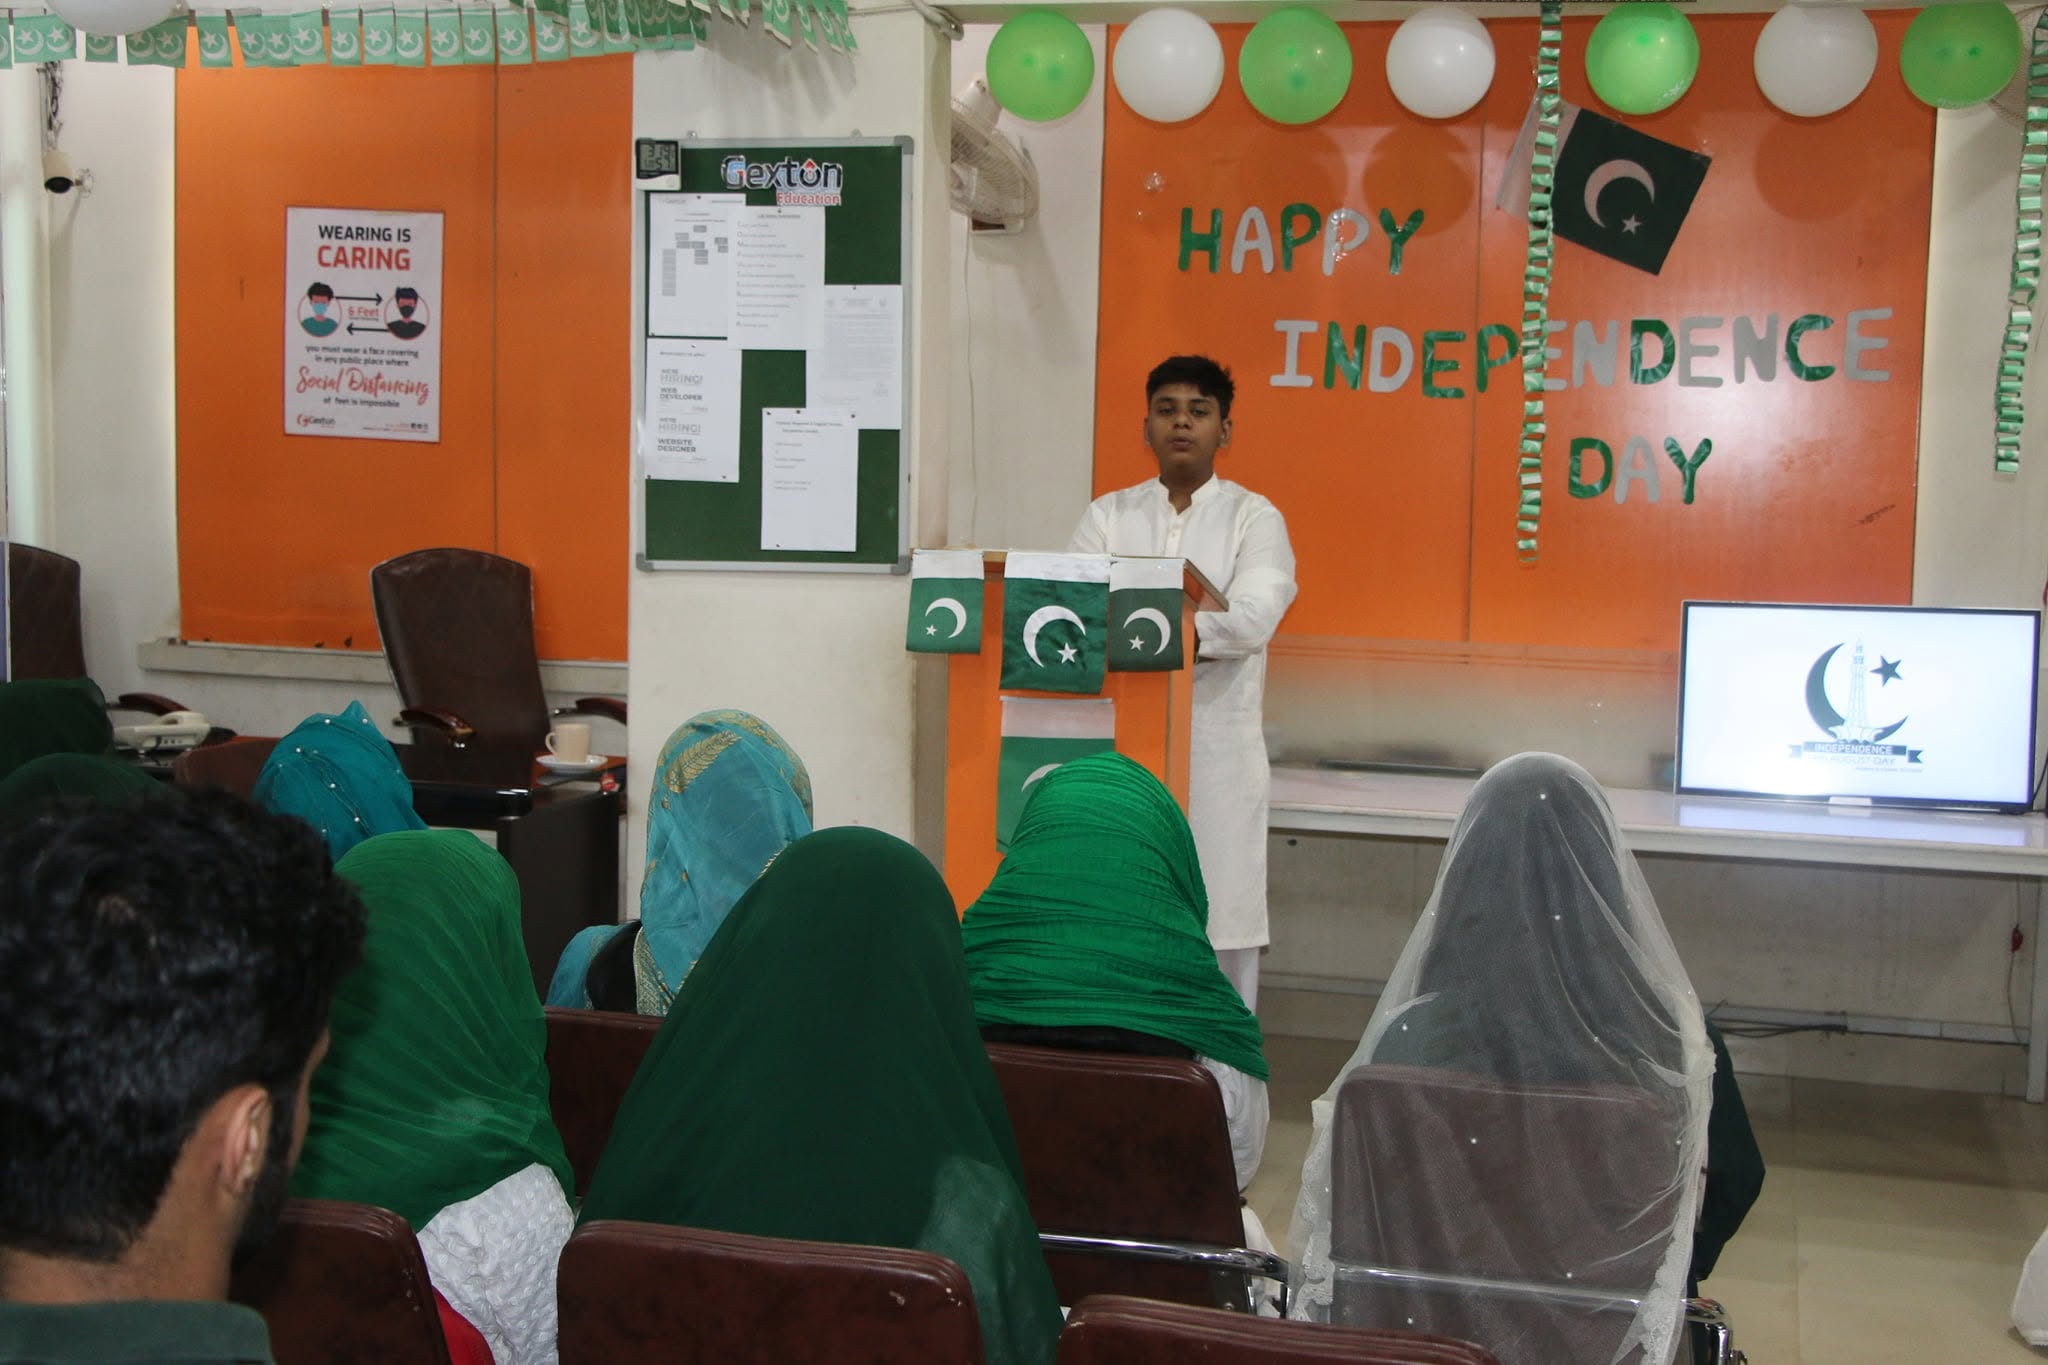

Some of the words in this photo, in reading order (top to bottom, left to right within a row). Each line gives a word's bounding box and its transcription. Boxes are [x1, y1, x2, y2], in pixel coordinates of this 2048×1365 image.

[721, 154, 842, 189] Gexton
[776, 191, 842, 205] Education
[318, 225, 392, 242] WEARING
[397, 228, 411, 242] IS
[1177, 202, 1425, 276] HAPPY
[317, 245, 411, 271] CARING
[348, 306, 354, 316] 6
[357, 306, 379, 317] Feet
[305, 345, 320, 353] you
[322, 345, 341, 353] must
[369, 347, 384, 355] face
[387, 349, 419, 358] covering
[1269, 307, 1894, 399] INDEPENDENCE
[340, 356, 361, 365] public
[363, 357, 383, 366] place
[386, 358, 408, 366] where
[296, 366, 344, 394] Social
[346, 367, 429, 406] Distancing
[660, 374, 703, 385] HIRING!
[359, 399, 400, 407] impossible
[658, 423, 702, 432] HIRING!
[657, 445, 697, 453] DESIGNER
[1567, 436, 1713, 505] DAY
[1814, 743, 1893, 755] INDEPENDENCE
